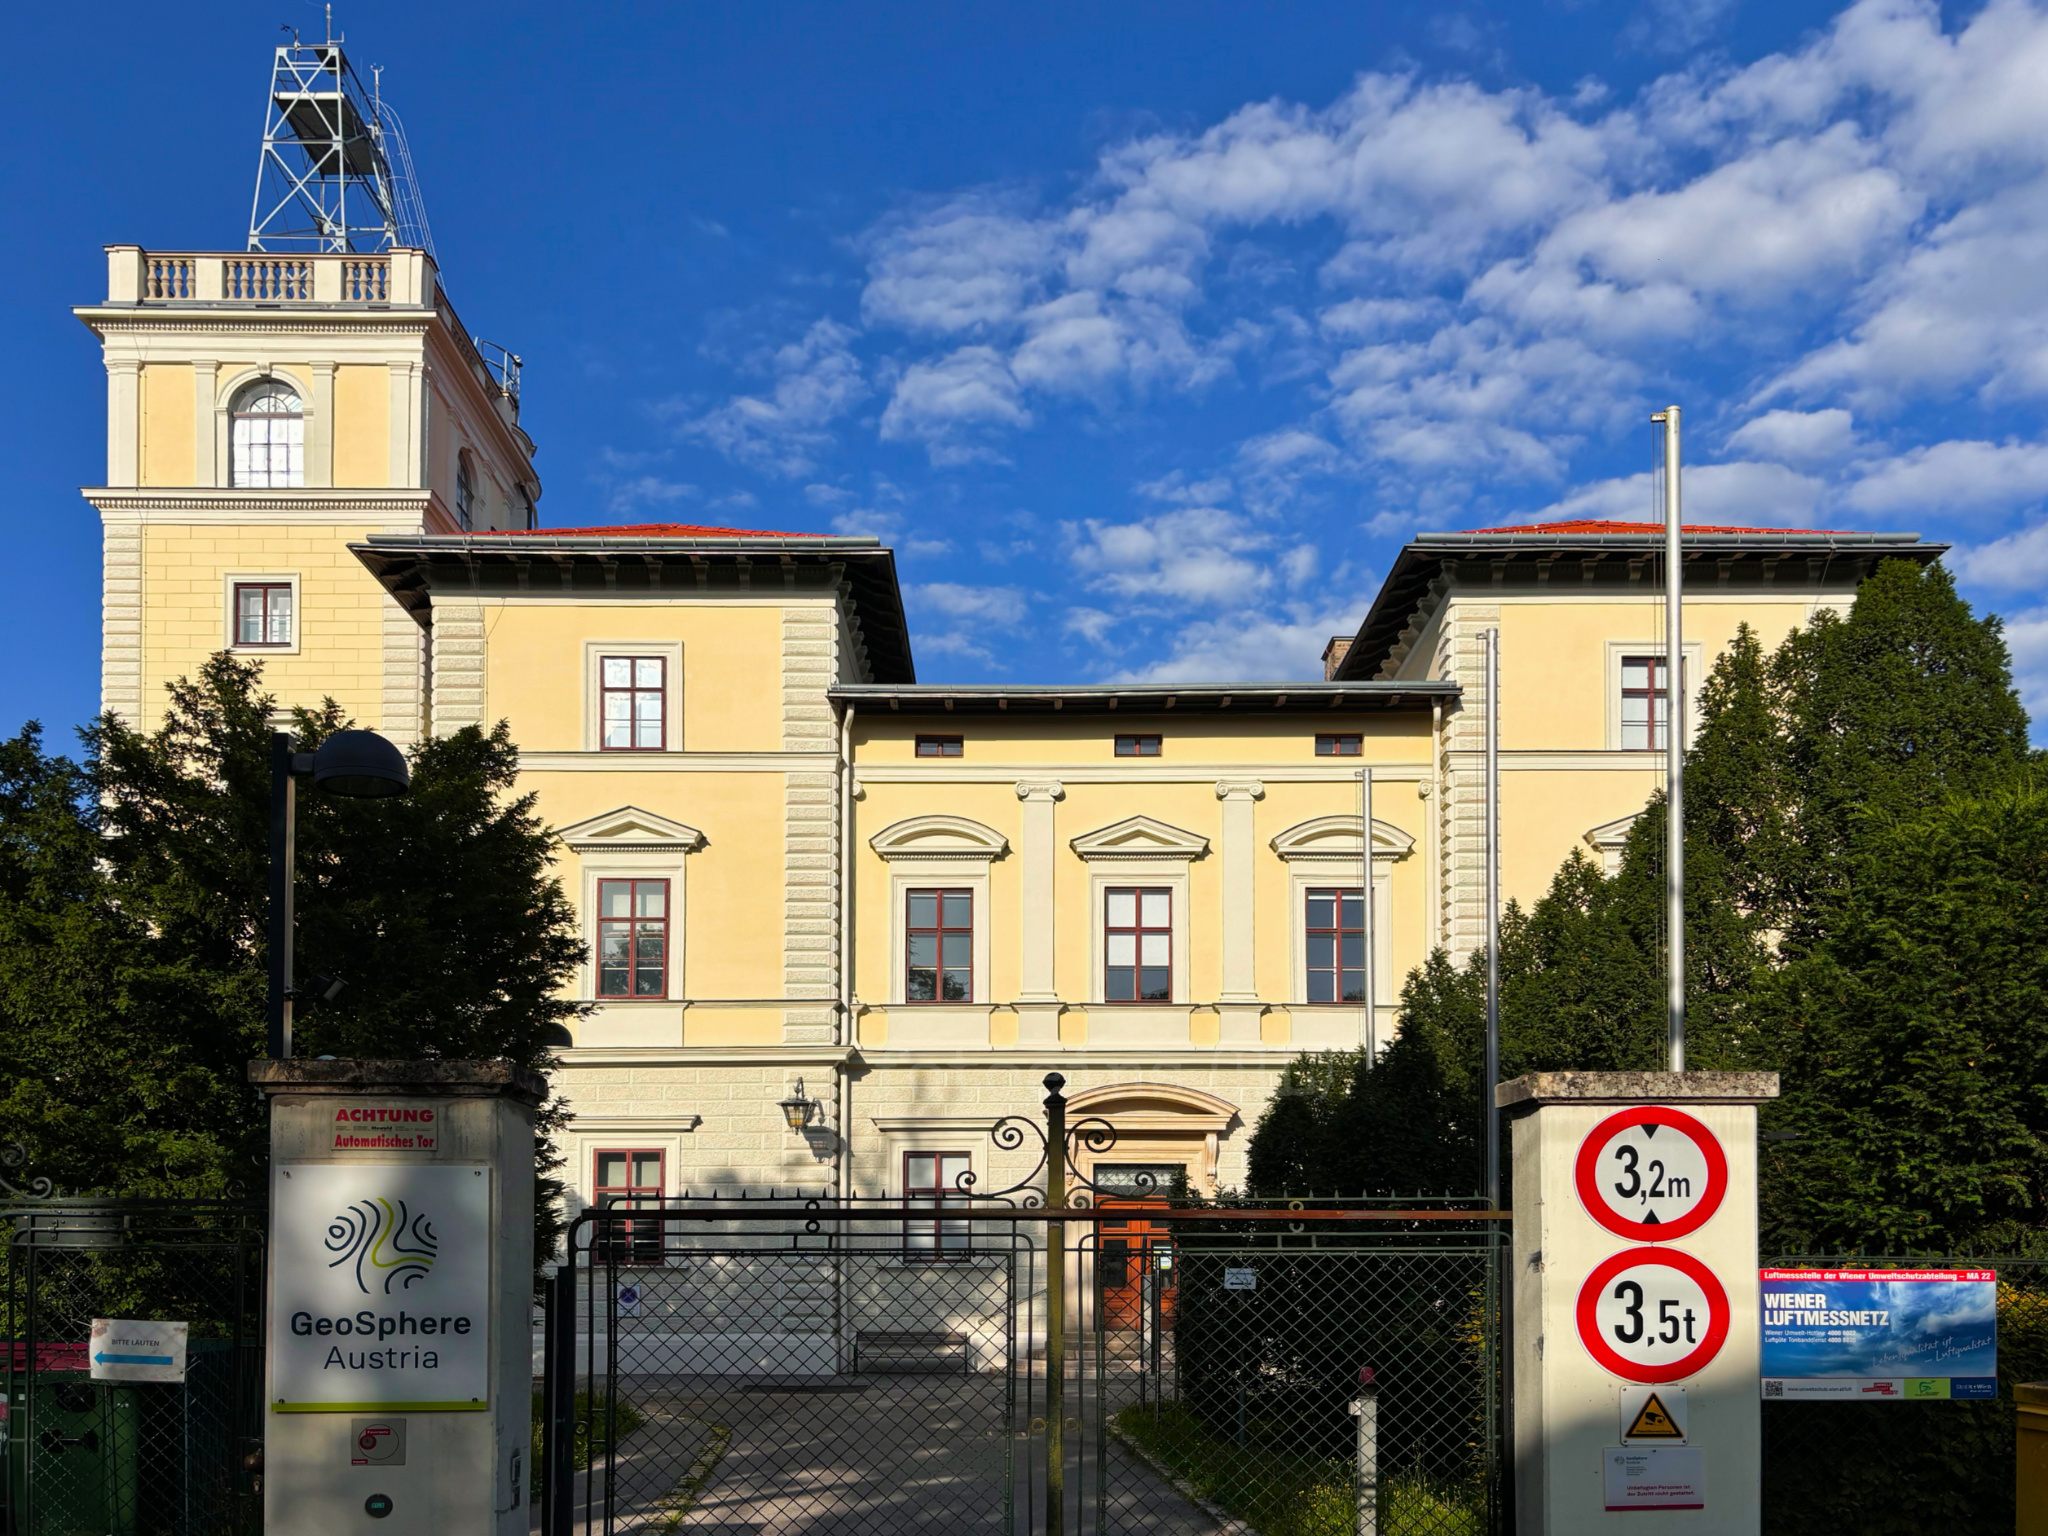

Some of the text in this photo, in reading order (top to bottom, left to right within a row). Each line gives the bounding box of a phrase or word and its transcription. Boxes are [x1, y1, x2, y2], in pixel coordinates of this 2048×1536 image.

[335, 1109, 434, 1122] ACHTUNG
[334, 1134, 434, 1148] Automatisches Tor
[1764, 1271, 1822, 1280] Luftmessstelle
[1823, 1272, 1837, 1280] der
[1839, 1272, 1866, 1280] Wiener
[1868, 1272, 1958, 1281] Umweltschutzabteilung
[1966, 1272, 1980, 1280] MA
[1981, 1272, 1991, 1280] 22
[1764, 1293, 1827, 1309] WIENER
[291, 1311, 471, 1341] GeoSphere
[1764, 1310, 1889, 1326] LUFTMESSNETZ
[131, 1339, 160, 1347] LÄUTEN
[1935, 1336, 1992, 1362] Luftqualität
[324, 1345, 438, 1370] Austria
